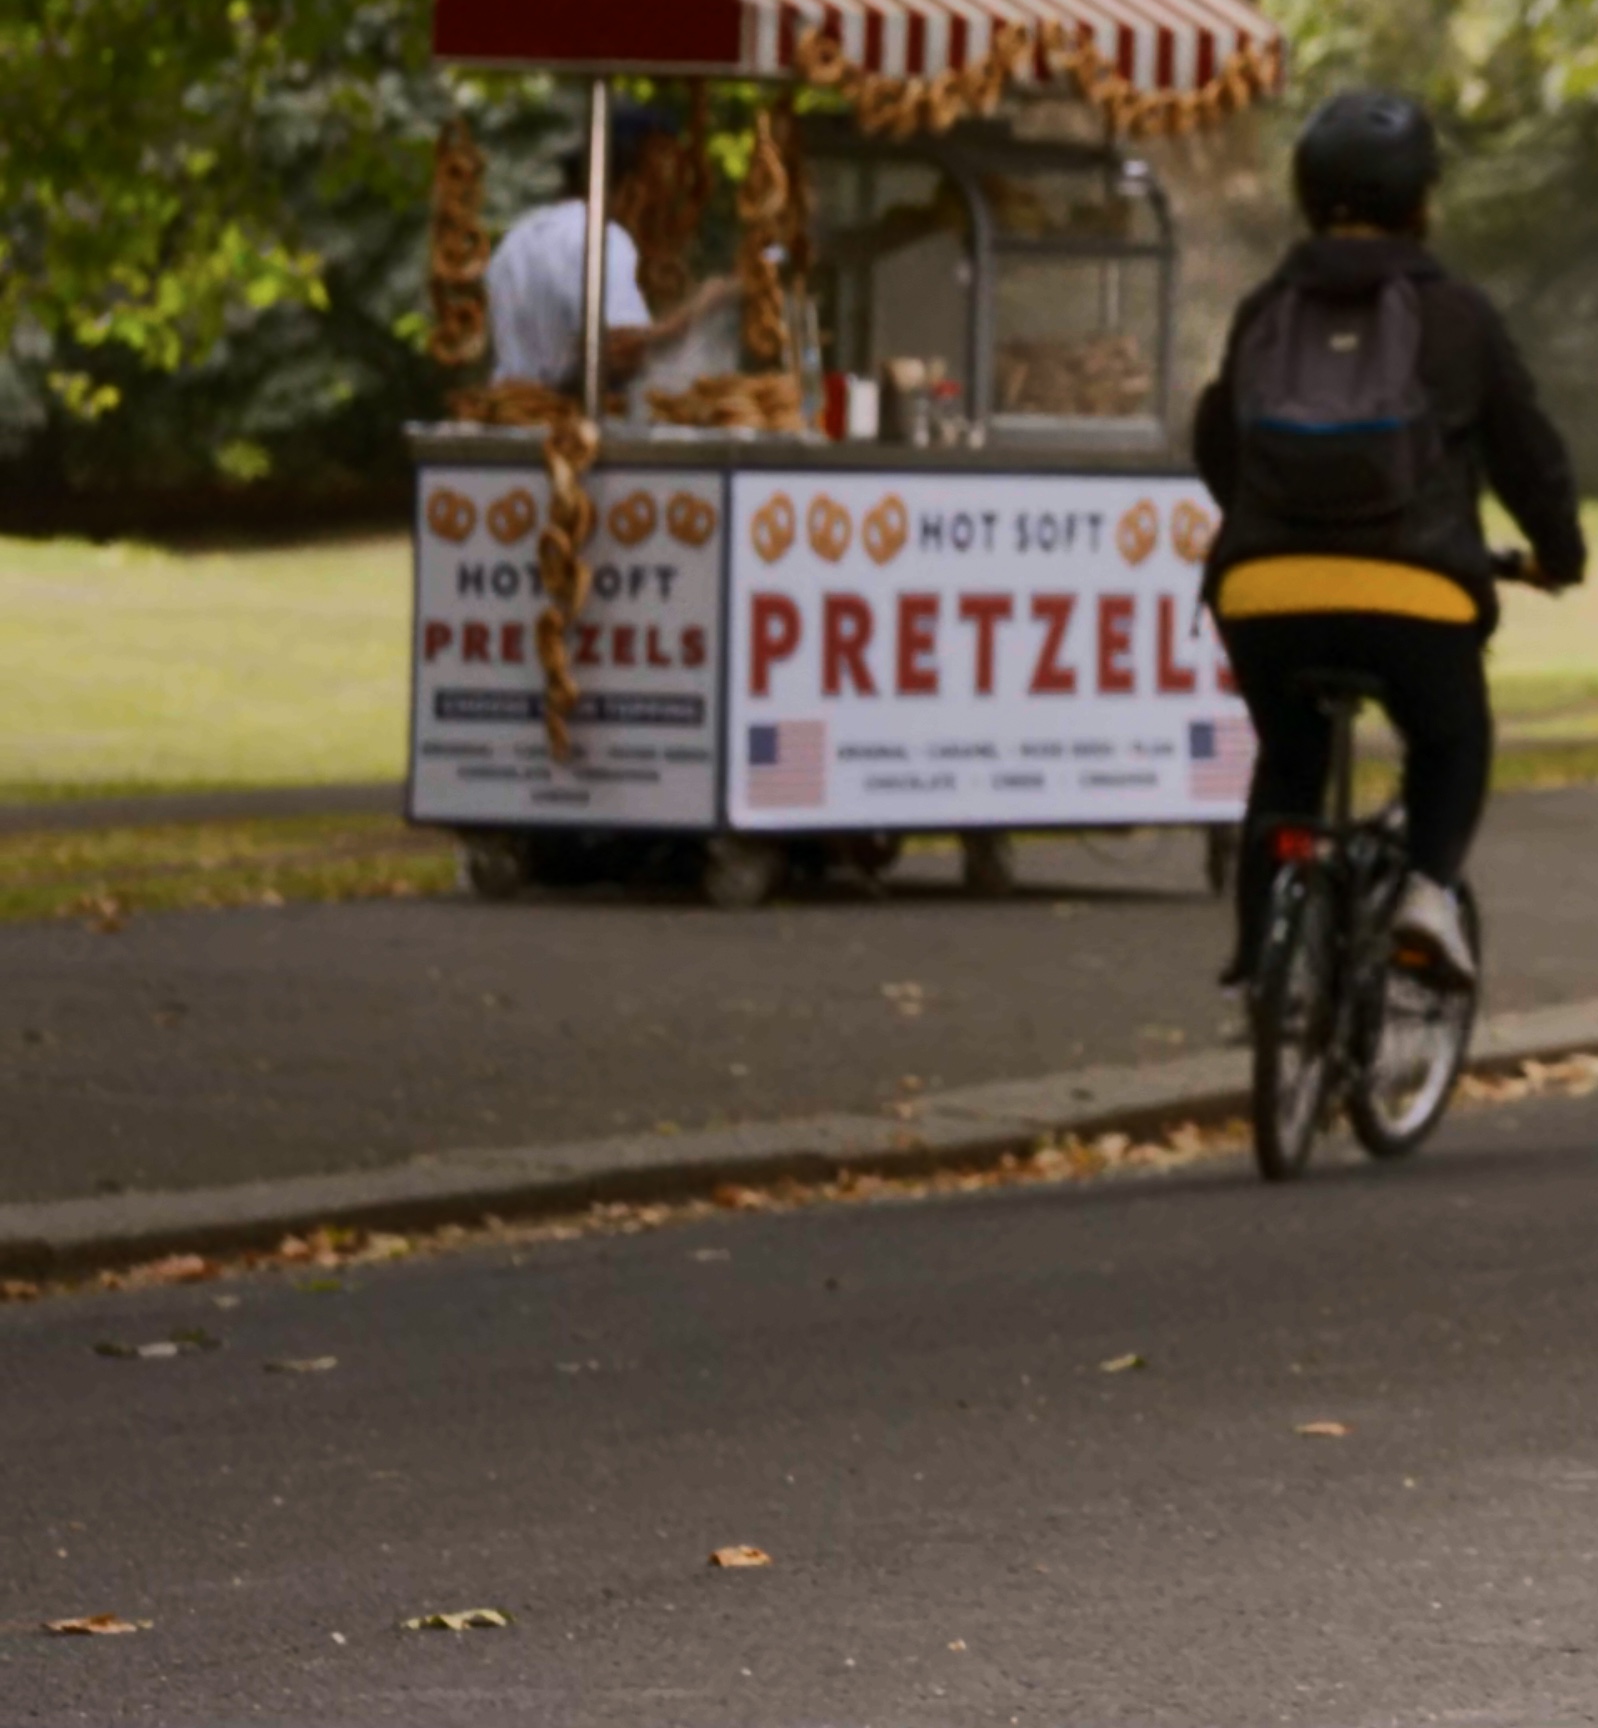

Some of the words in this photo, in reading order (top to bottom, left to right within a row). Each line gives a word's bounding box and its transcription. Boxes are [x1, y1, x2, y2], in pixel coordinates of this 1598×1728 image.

[919, 512, 997, 554] HOT
[1015, 512, 1105, 554] SOFT
[593, 564, 678, 601] OFT
[423, 620, 707, 668] PREZELS
